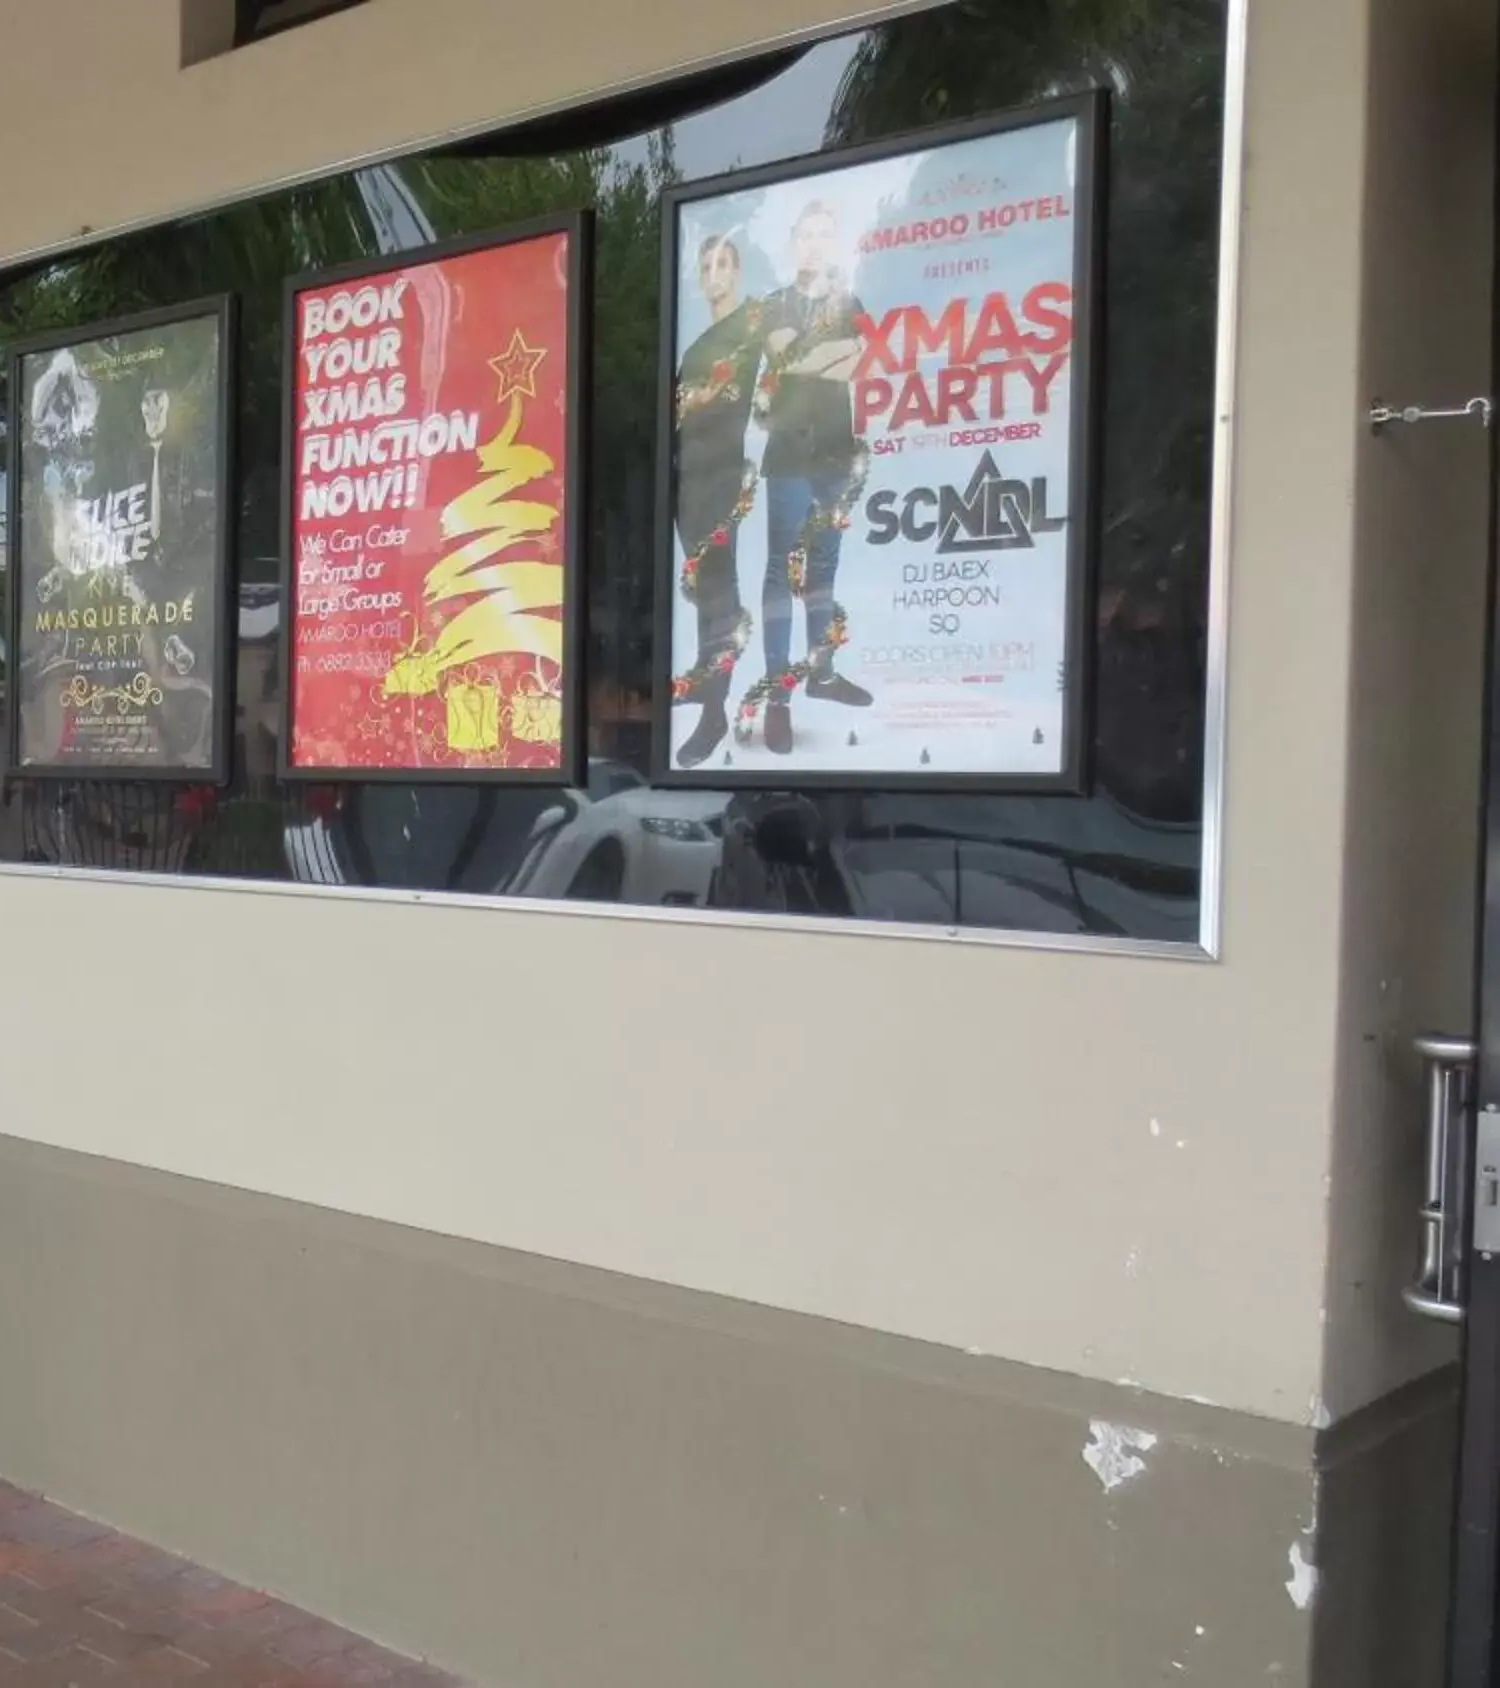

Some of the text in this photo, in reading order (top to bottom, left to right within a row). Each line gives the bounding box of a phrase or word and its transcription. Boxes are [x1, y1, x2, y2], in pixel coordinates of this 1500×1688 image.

[859, 213, 969, 253] AMAROO
[977, 195, 1071, 232] HOTEL
[303, 278, 407, 340] BOOK
[850, 281, 1075, 380] XMAS
[303, 328, 401, 384] YOUR
[300, 373, 406, 430] XMAS
[852, 352, 1070, 434] PARTY
[301, 410, 480, 475] FUNCTION
[872, 437, 906, 455] SAT
[949, 422, 1043, 447] DECEMBER
[300, 464, 419, 521] NOW!!
[300, 524, 411, 555] We Can Cater
[322, 553, 365, 584] Small
[365, 562, 386, 579] or
[902, 559, 991, 584] DJ BAEX
[298, 588, 403, 620] Large Groups
[892, 585, 1000, 610] HARPOON
[35, 599, 194, 633] MASQUERADE
[298, 622, 359, 643] AMAROO
[74, 633, 146, 658] PARTY
